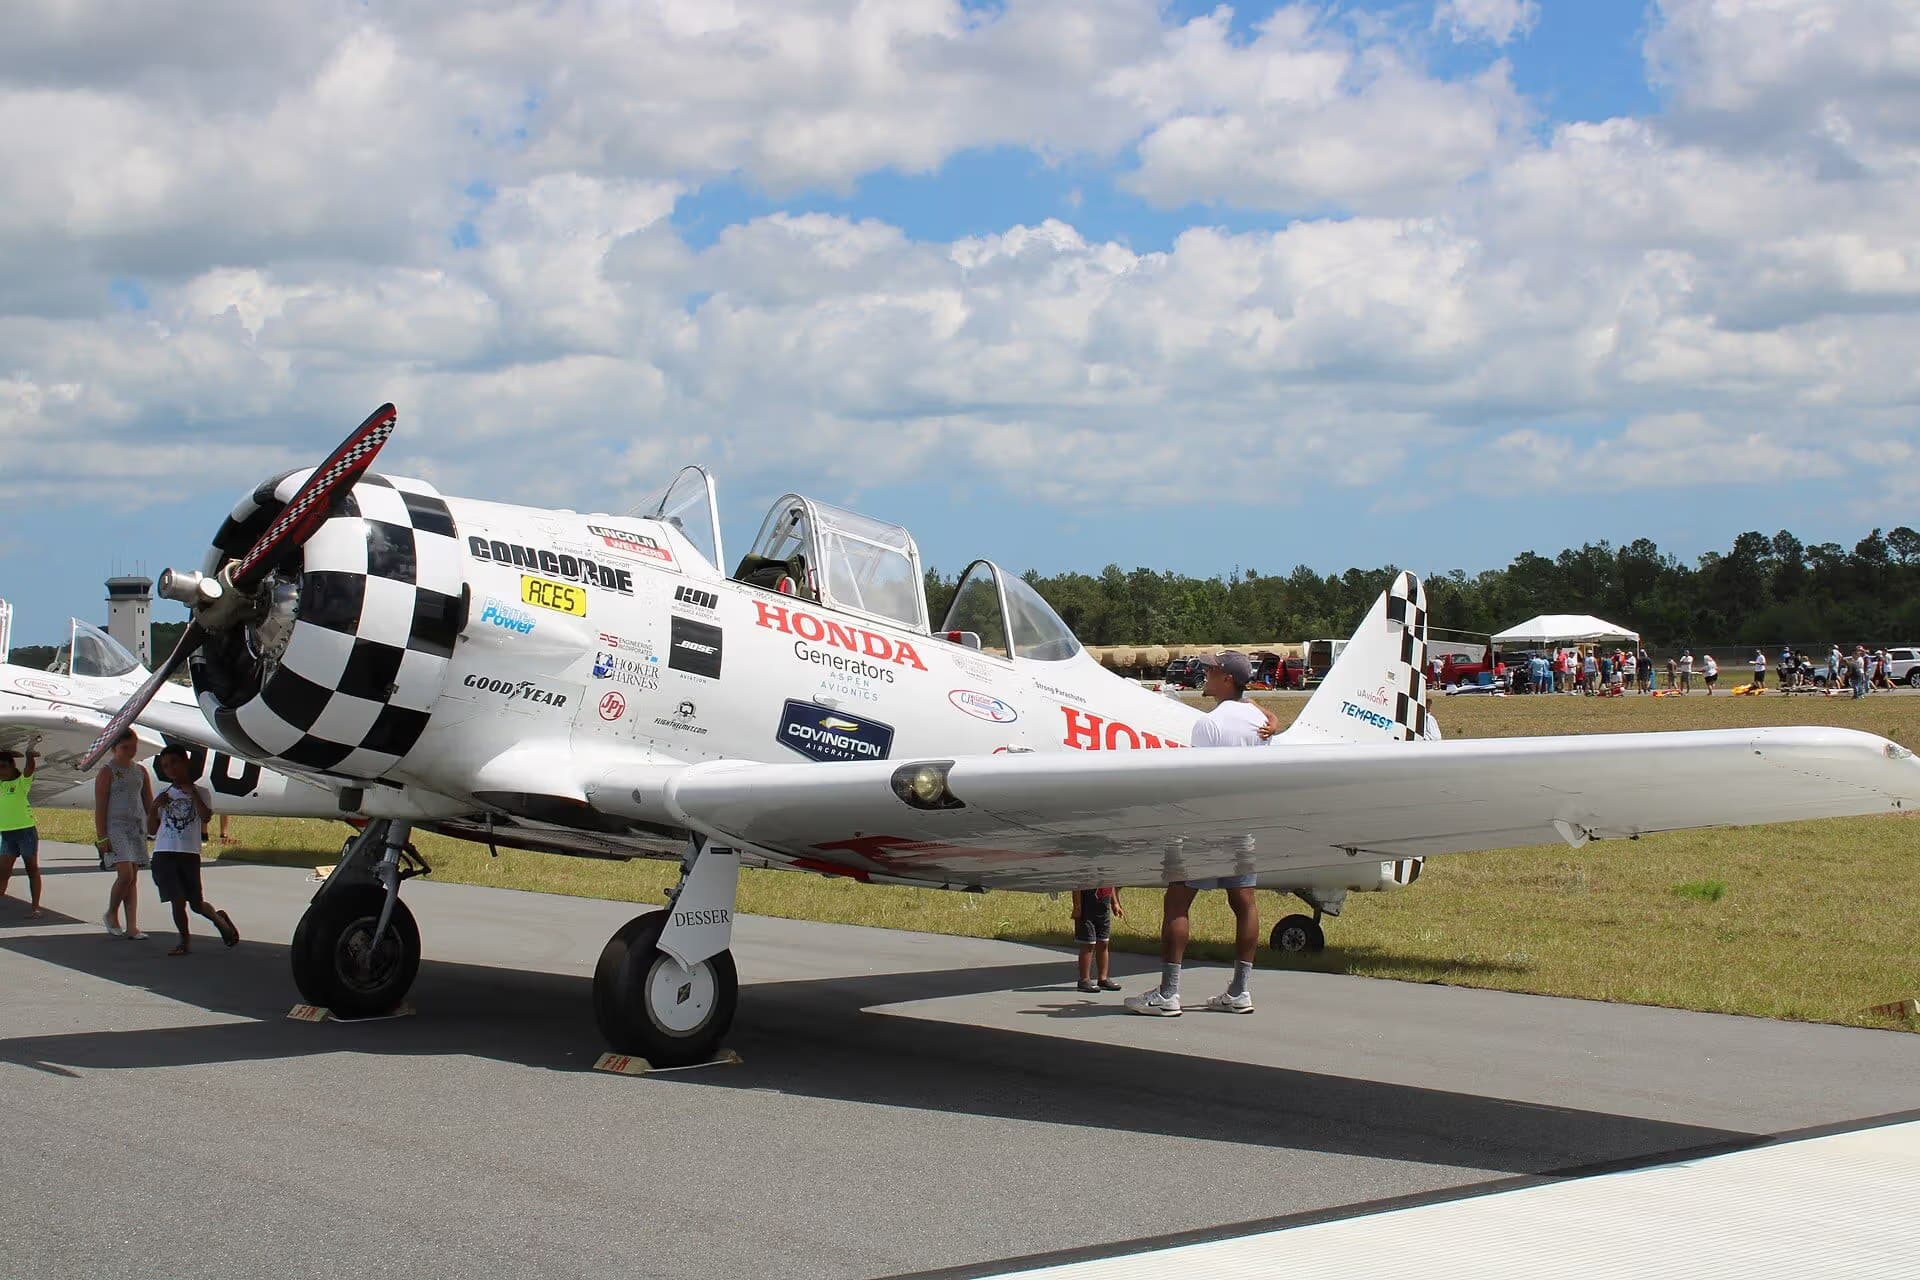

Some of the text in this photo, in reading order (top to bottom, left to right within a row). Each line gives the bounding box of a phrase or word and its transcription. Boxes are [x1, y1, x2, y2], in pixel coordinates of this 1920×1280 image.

[589, 526, 657, 548] LINCOLN
[468, 536, 634, 596] CONCORDE
[529, 580, 575, 612] ACES
[481, 607, 535, 635] Power
[752, 600, 928, 672] HONDA
[675, 640, 719, 655] BOSE
[615, 657, 660, 679] HOOKER
[794, 641, 895, 684] Generators
[612, 670, 658, 691] HARNESS
[830, 671, 870, 688] ASPEN
[820, 680, 879, 702] AVIONICS
[1341, 700, 1393, 731] TEMPEST
[788, 723, 881, 757] COVINGTON
[806, 742, 856, 760] AIRCRAFT
[674, 909, 731, 927] DESSER
